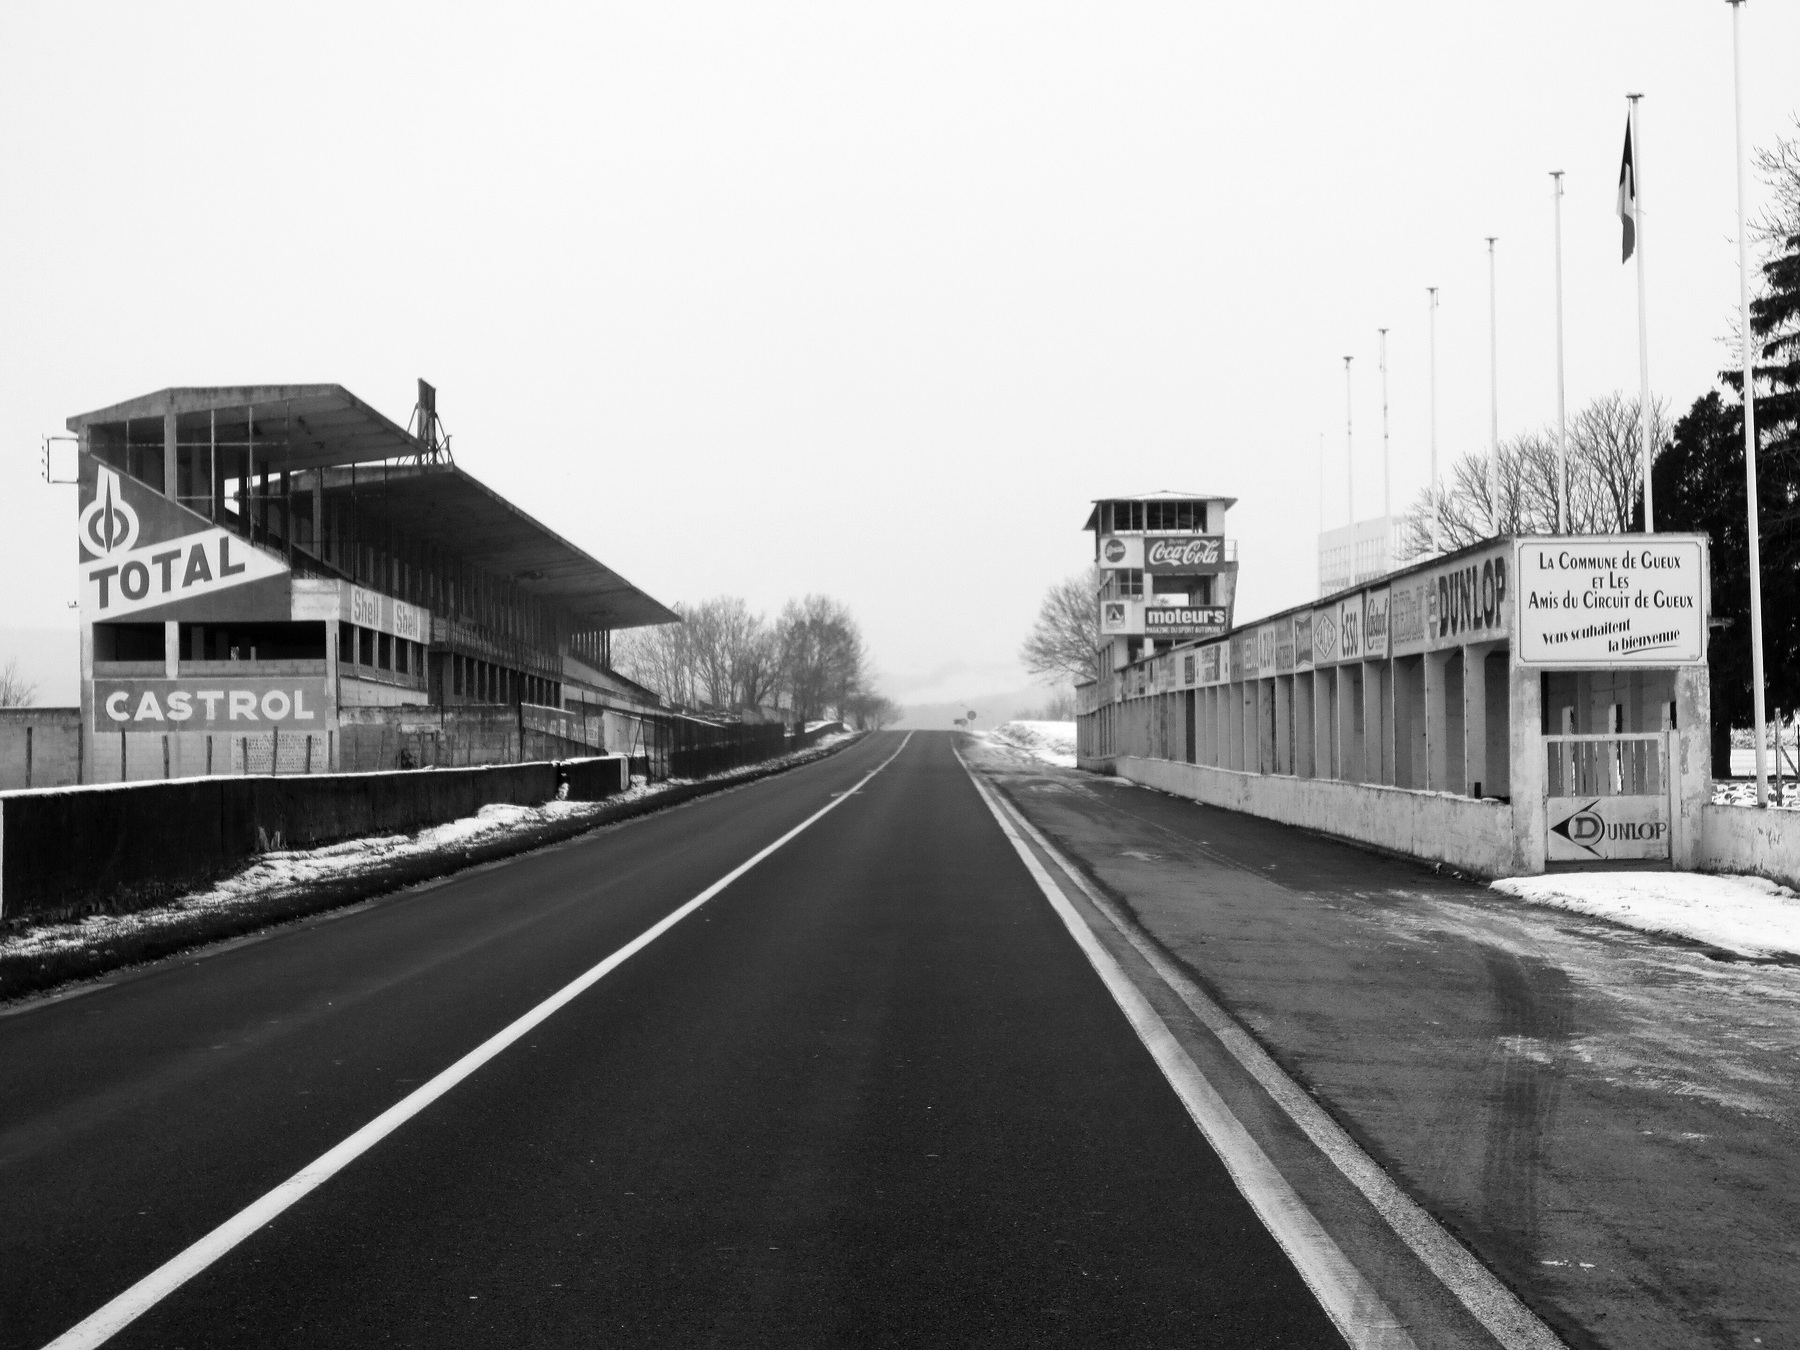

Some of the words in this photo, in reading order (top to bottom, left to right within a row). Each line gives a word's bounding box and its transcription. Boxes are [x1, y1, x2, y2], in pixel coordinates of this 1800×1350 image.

[1149, 540, 1220, 566] Coca-Cola
[89, 536, 246, 610] TOTAL
[354, 589, 379, 627] Shell
[1439, 556, 1506, 638] DUNLOP
[396, 604, 418, 637] Shell
[1148, 608, 1225, 624] moteurs
[1571, 618, 1630, 640] souhaitent
[1608, 639, 1619, 652] la
[1621, 629, 1680, 650] bienvenue
[105, 690, 315, 721] CASTROL
[1573, 817, 1667, 840] DUNLOP
